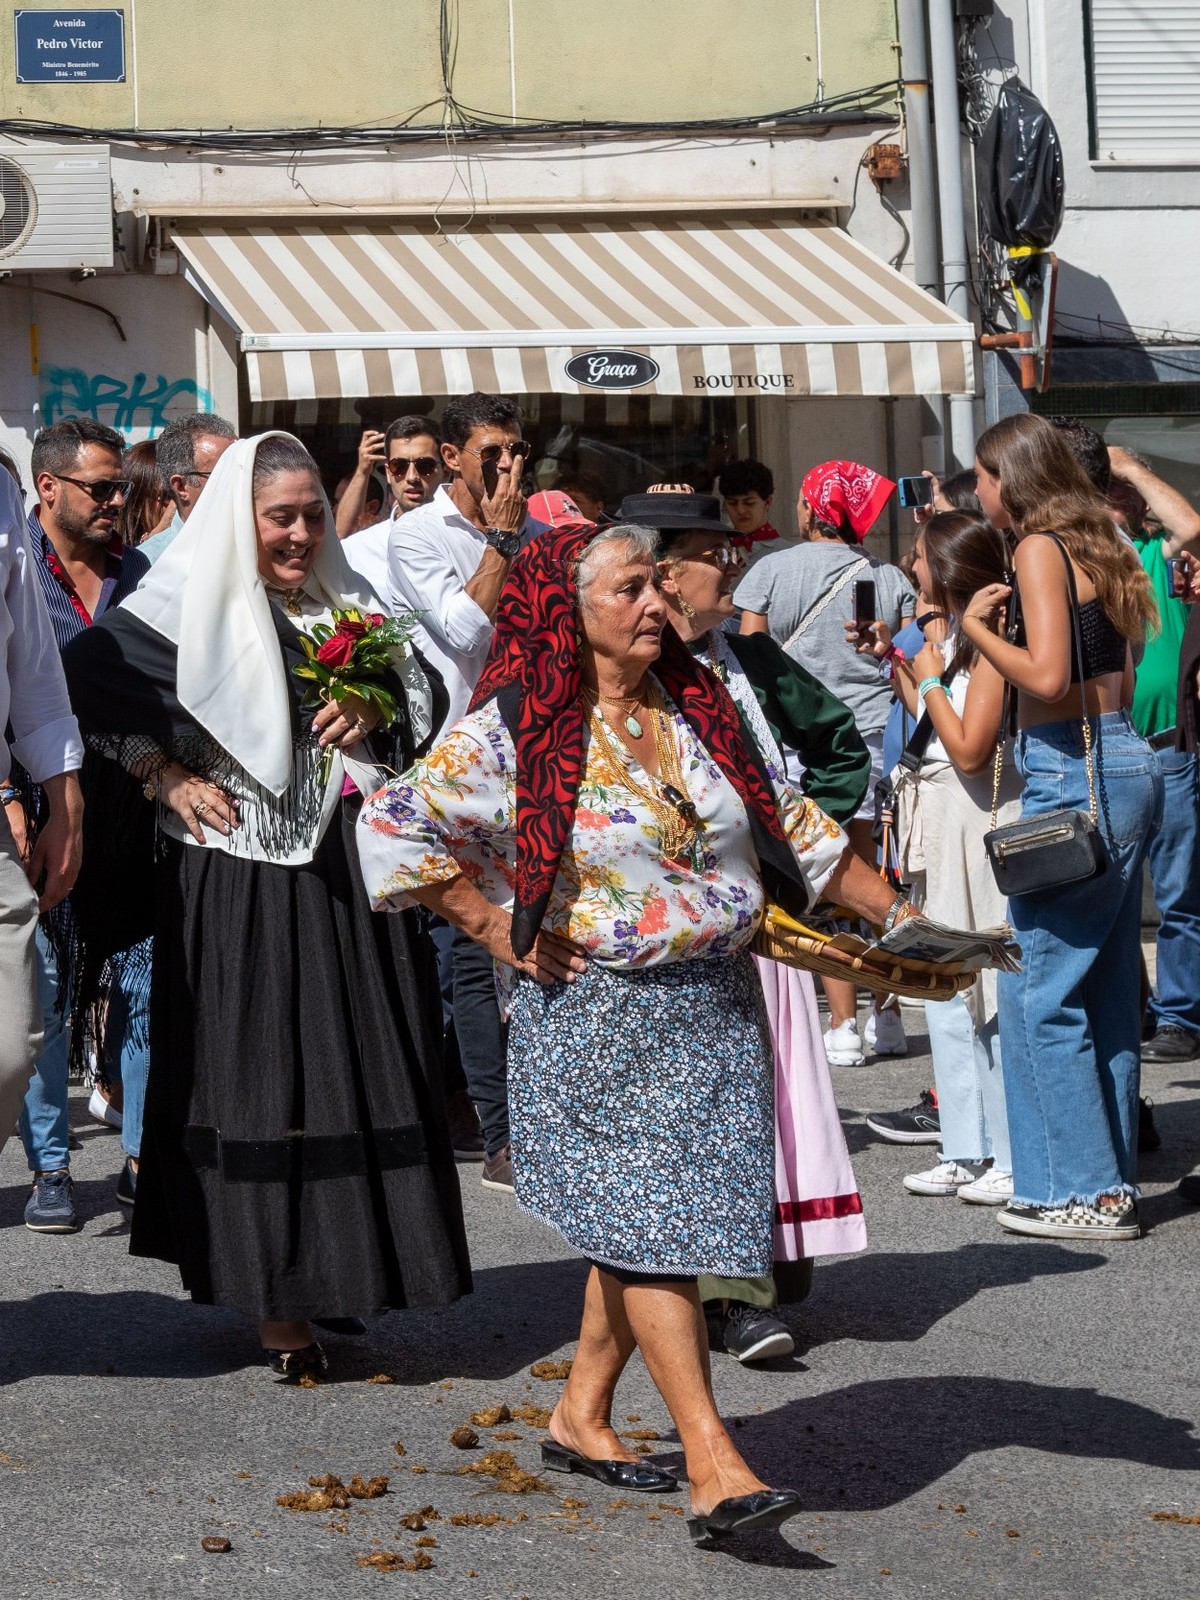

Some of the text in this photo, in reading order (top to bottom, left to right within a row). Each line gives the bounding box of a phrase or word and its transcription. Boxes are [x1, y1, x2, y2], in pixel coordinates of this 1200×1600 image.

[53, 19, 86, 27] Avenida
[36, 38, 104, 49] Pedro Victor
[587, 356, 638, 383] Graça
[693, 374, 795, 390] BOUTIQUE
